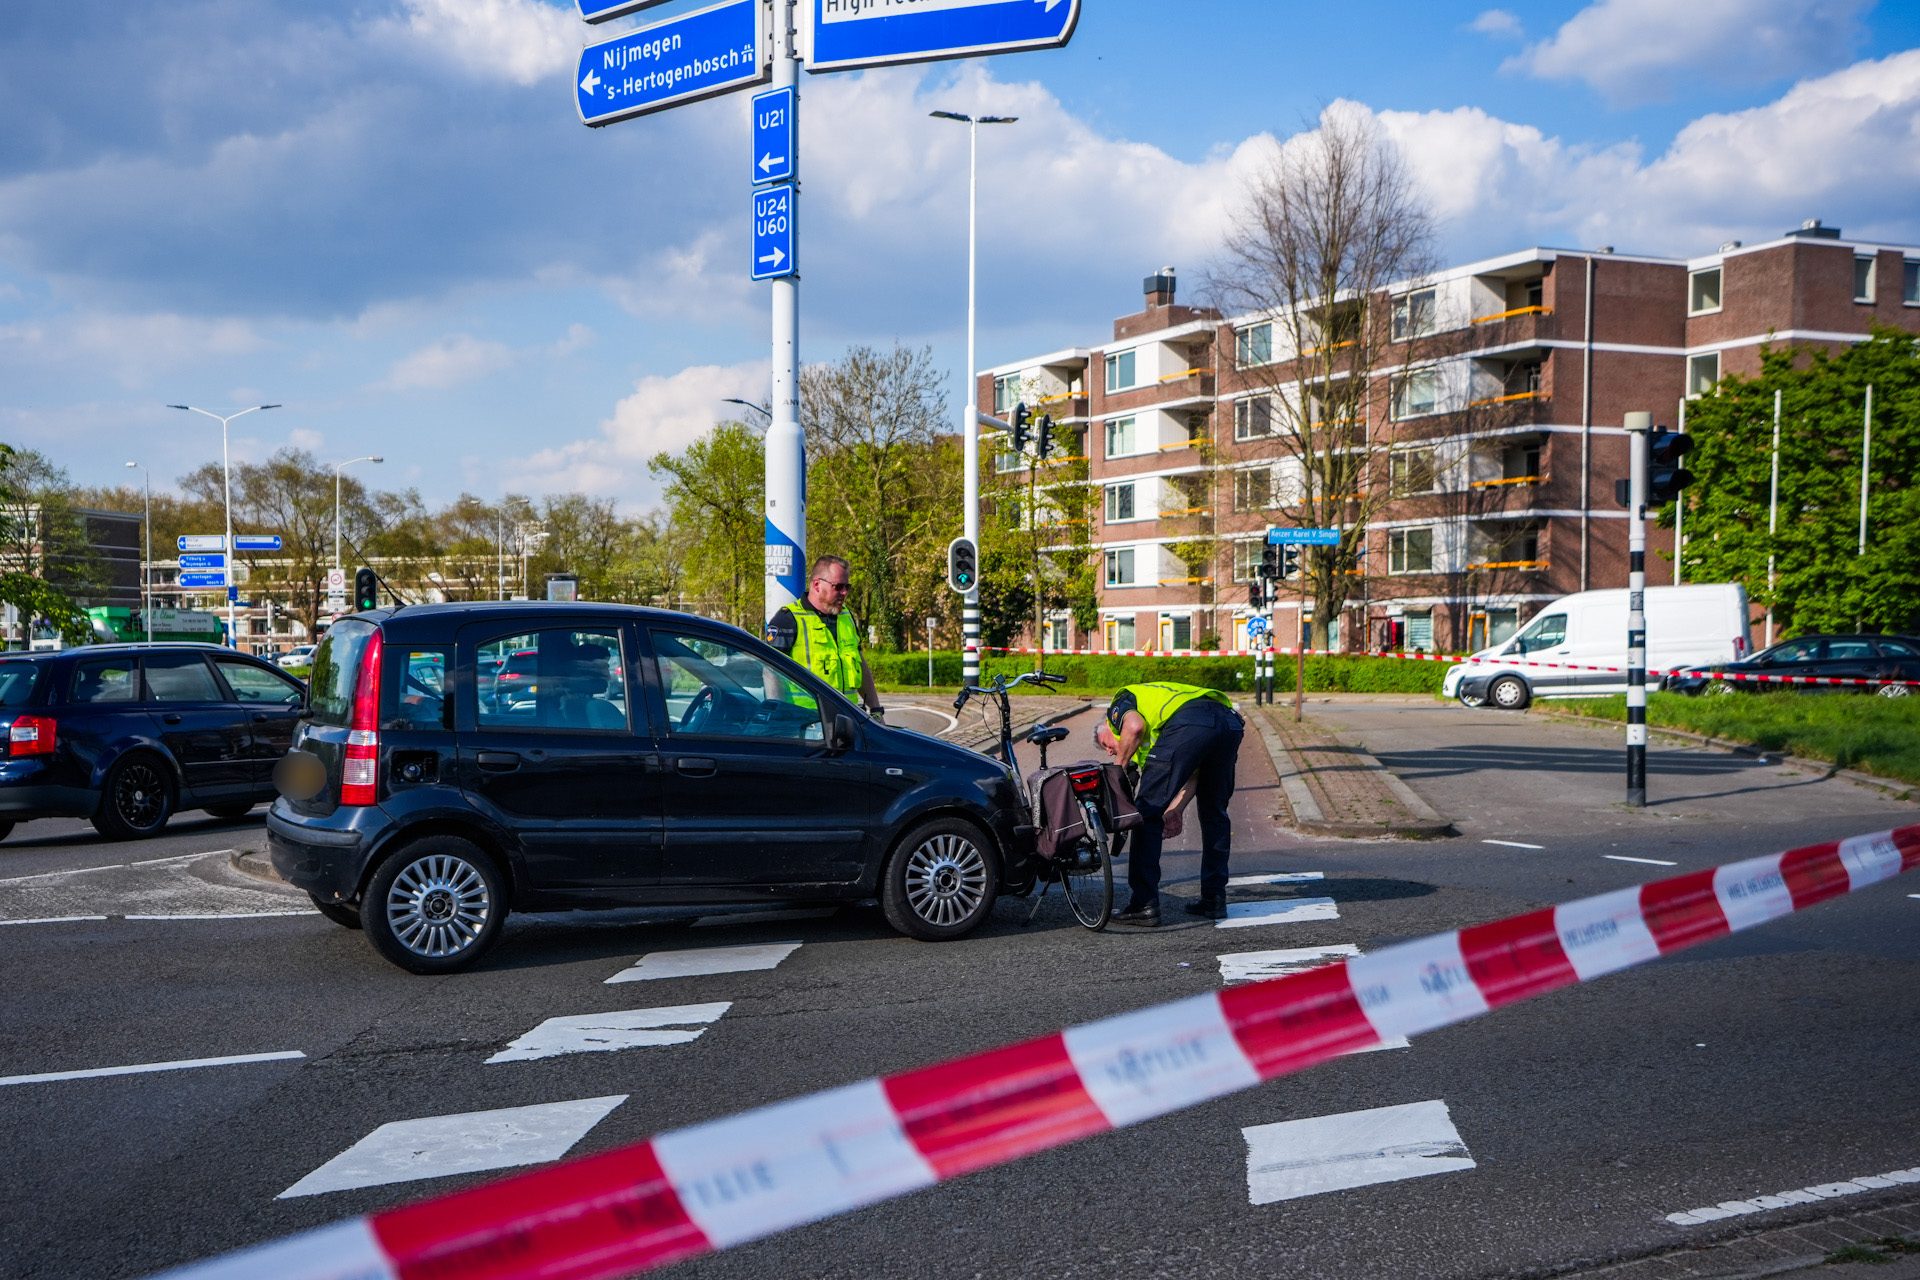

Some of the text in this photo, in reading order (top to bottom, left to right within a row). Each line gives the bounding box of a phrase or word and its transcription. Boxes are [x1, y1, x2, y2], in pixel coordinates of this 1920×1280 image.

[603, 33, 682, 70] Nijmegen
[603, 49, 739, 100] 's-Hertogenbosch
[759, 108, 785, 130] U21
[757, 195, 787, 217] U24
[757, 216, 787, 236] U60
[1293, 529, 1310, 538] Karel
[1319, 530, 1338, 539] Singel
